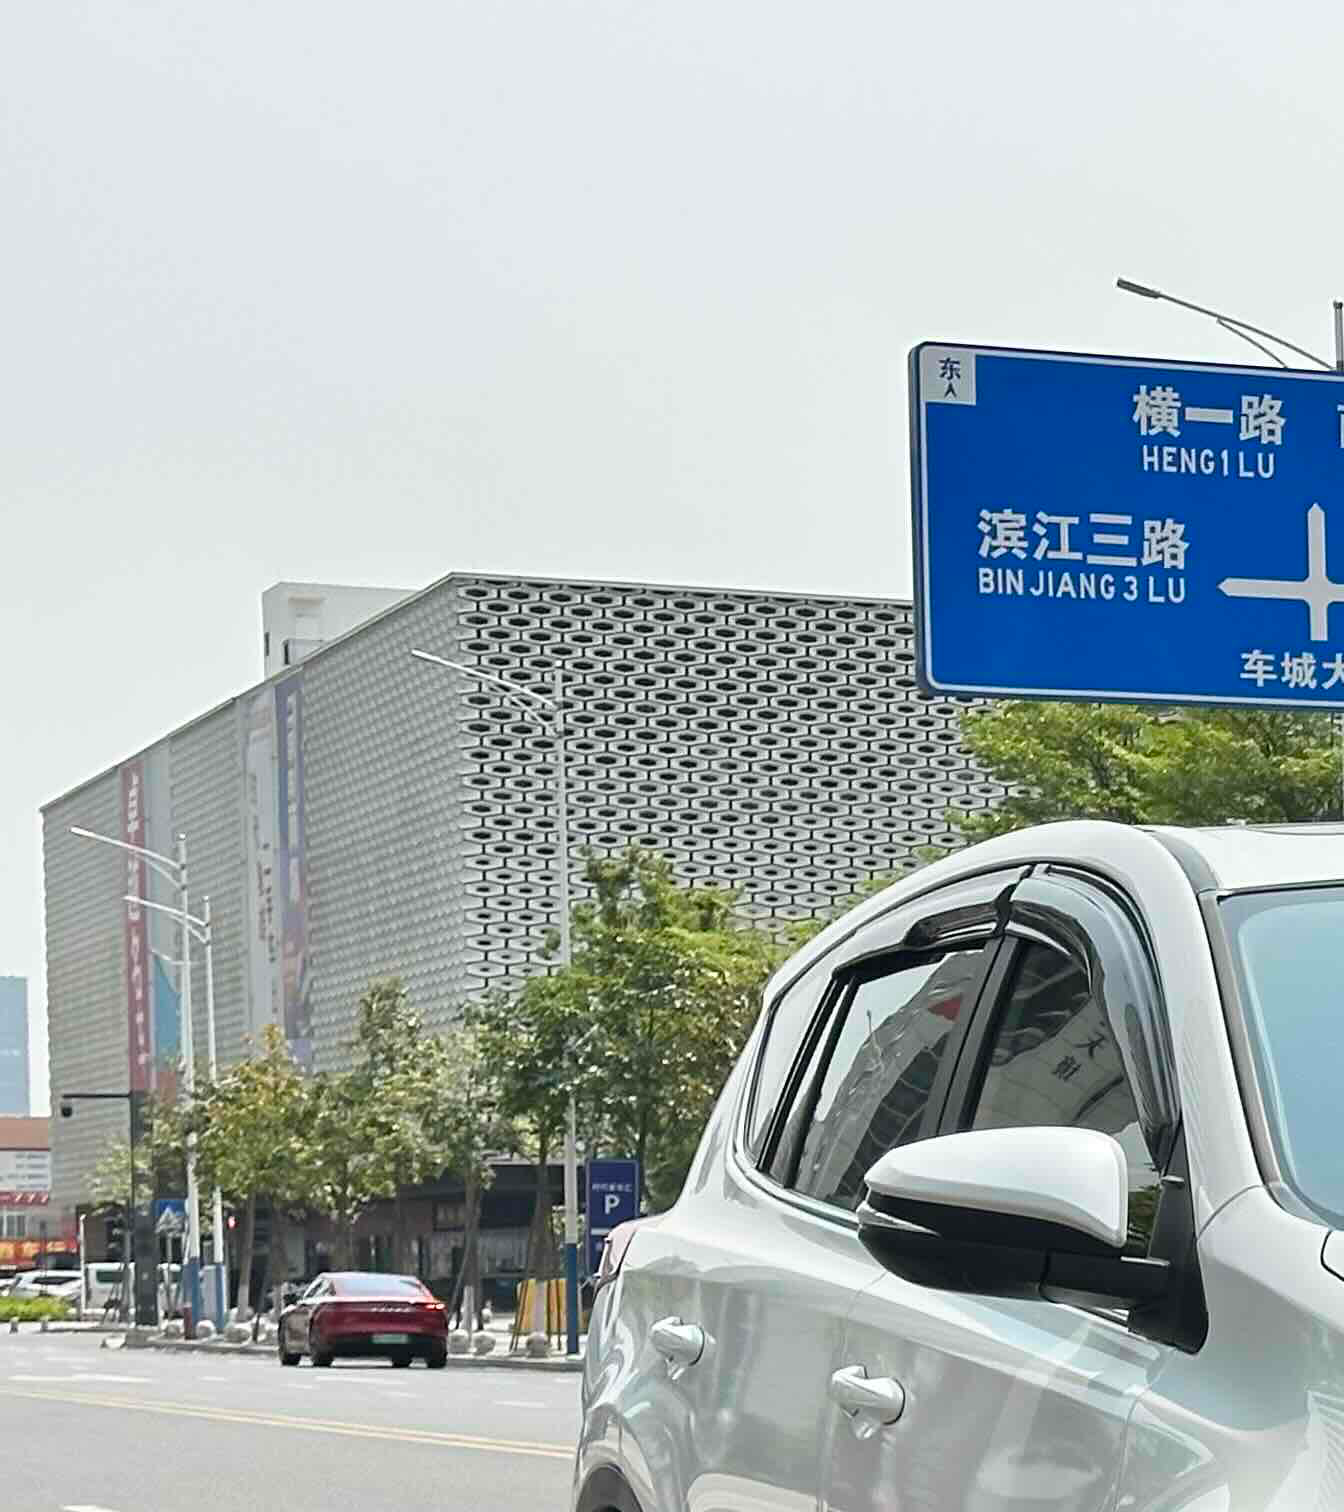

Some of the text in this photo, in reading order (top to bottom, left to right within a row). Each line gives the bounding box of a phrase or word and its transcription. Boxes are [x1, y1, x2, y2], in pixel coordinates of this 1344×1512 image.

[938, 357, 961, 380] 东
[1132, 385, 1286, 445] 横一路
[977, 508, 1190, 570] 滨江三路
[605, 1194, 620, 1215] P
